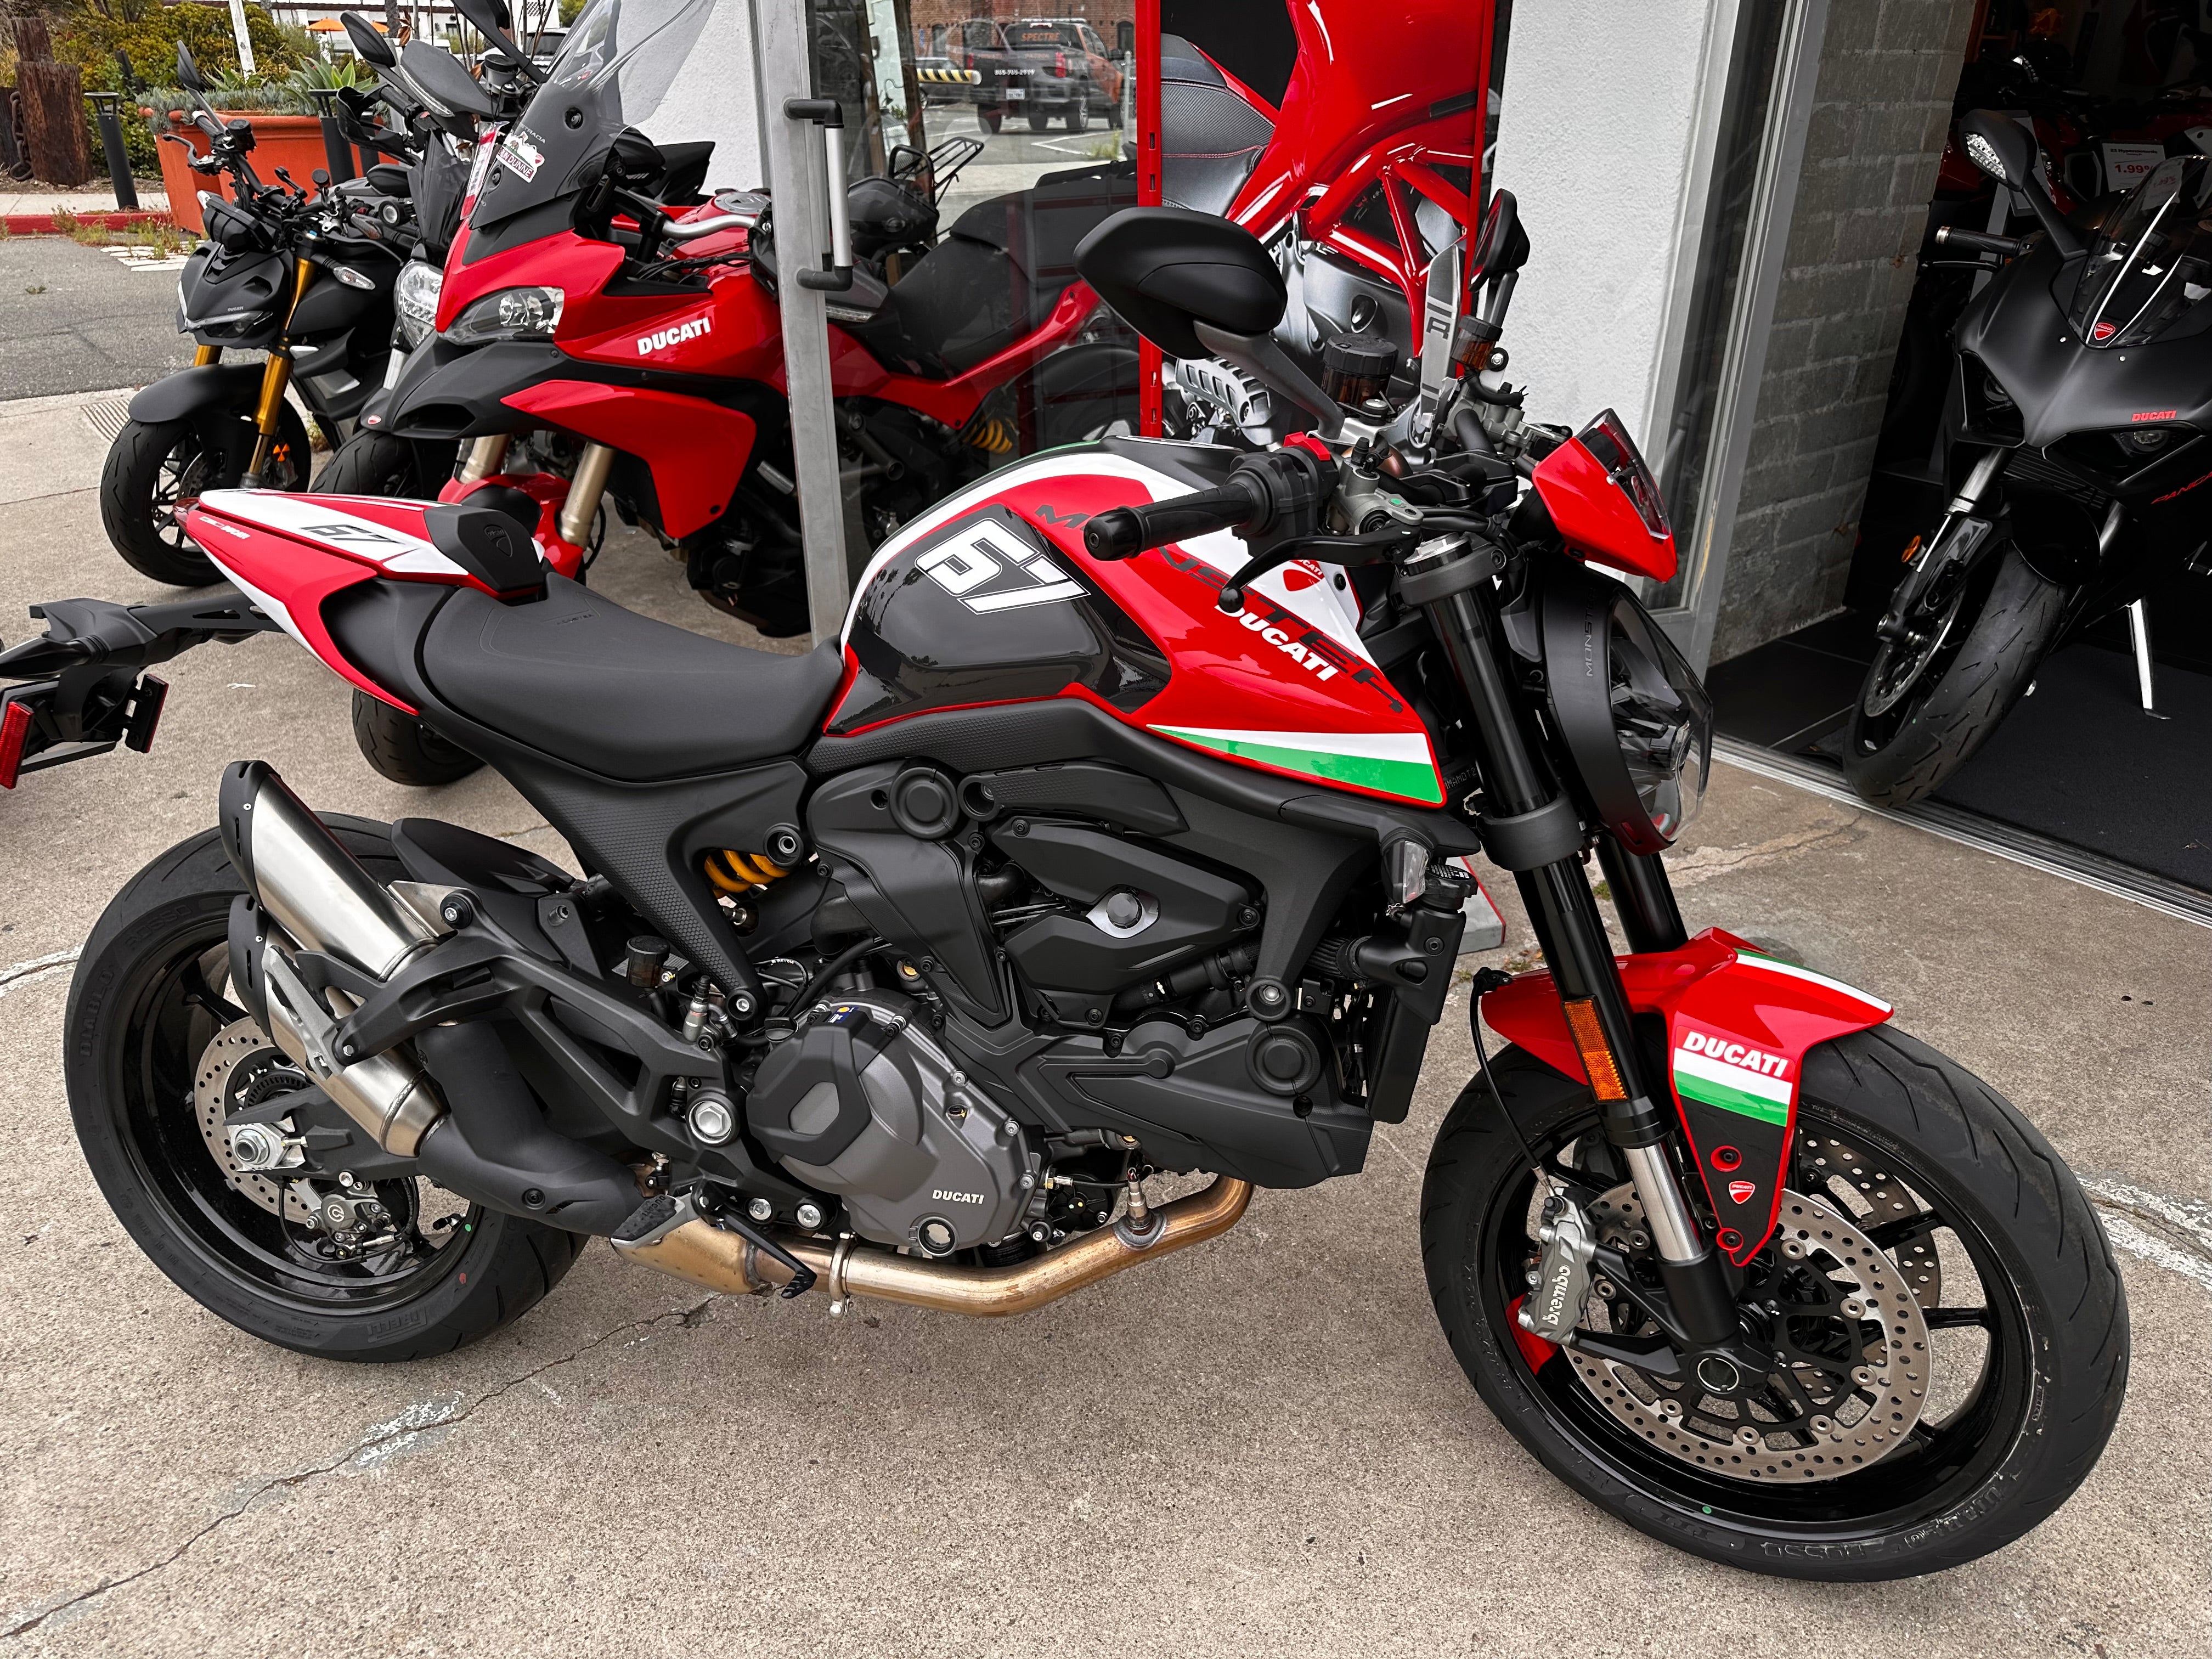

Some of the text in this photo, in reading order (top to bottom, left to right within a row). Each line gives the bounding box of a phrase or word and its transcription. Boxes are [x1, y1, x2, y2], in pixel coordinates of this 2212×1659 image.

[1021, 32, 1060, 42] SPECTRE
[507, 156, 533, 177] DUNNE
[637, 317, 712, 356] DUCATI
[2132, 410, 2176, 422] DUCATI
[221, 525, 251, 540] DUCATI
[298, 524, 405, 545] 67
[915, 517, 1091, 616] 67
[1299, 559, 1322, 576] CATI
[1585, 588, 1597, 678] MONSTER
[1683, 1031, 1788, 1079] DUCATI
[932, 1189, 984, 1205] DUCATI
[1541, 1263, 1571, 1326] brembo
